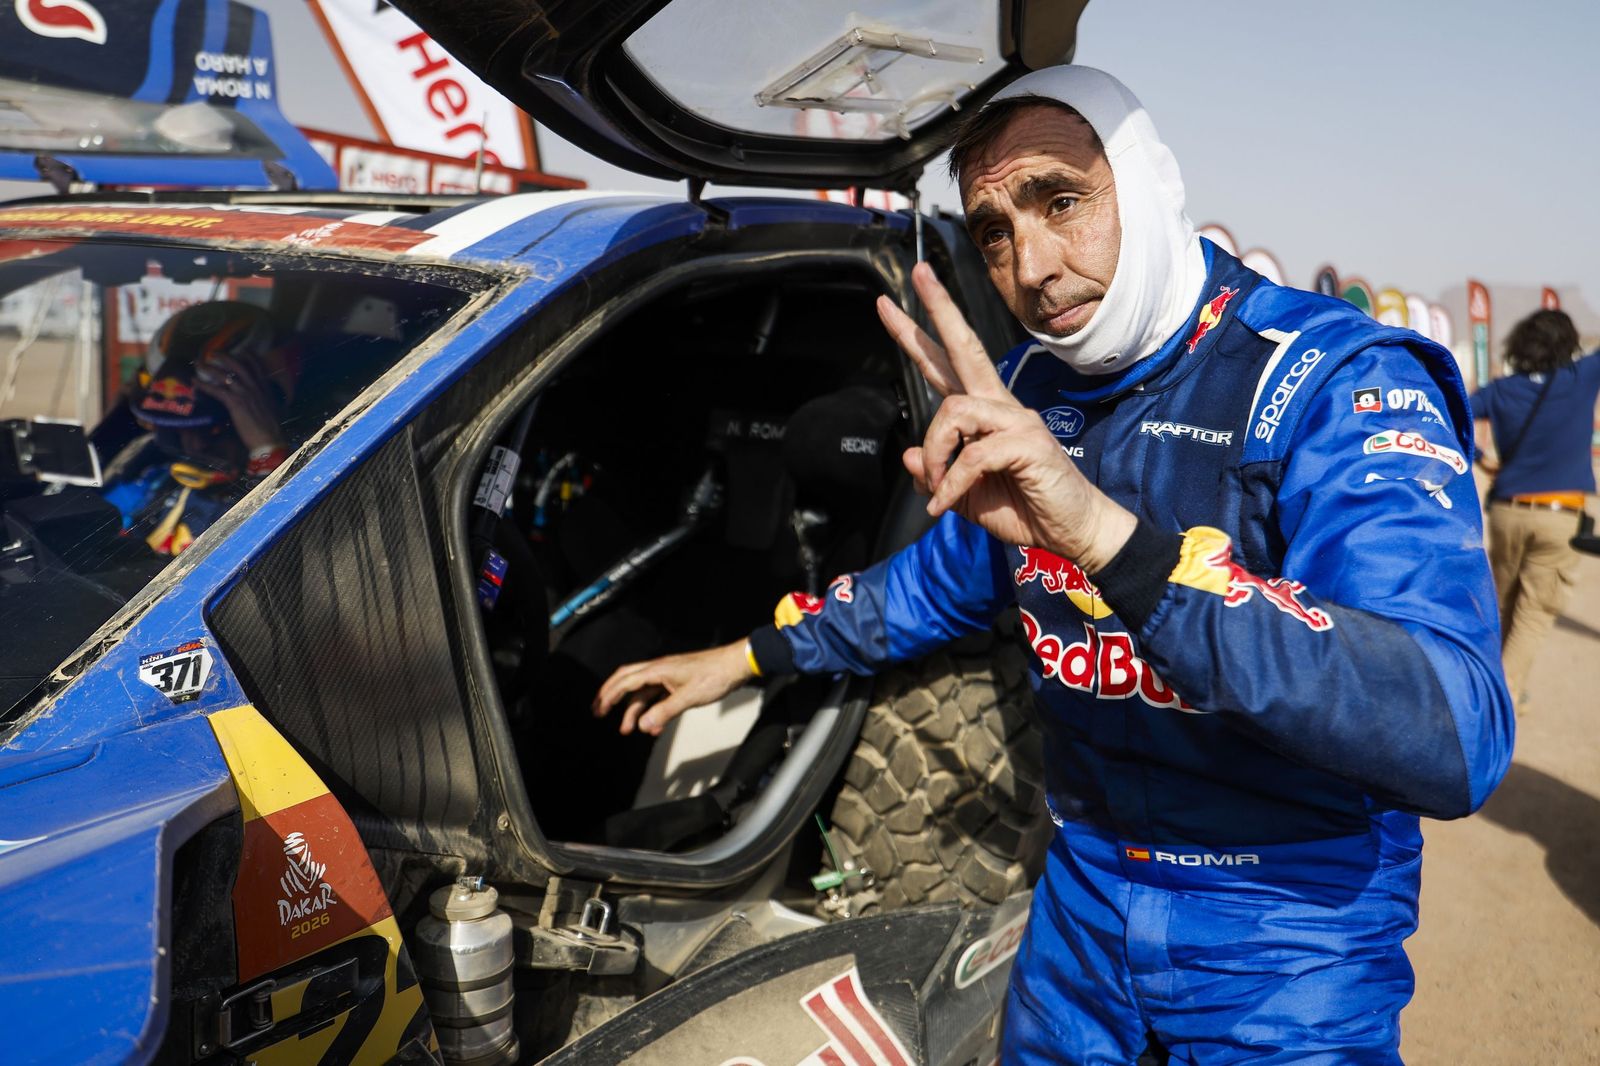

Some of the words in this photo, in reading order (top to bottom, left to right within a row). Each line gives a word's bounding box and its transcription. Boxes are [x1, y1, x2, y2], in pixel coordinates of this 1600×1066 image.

[195, 51, 253, 76] HARO
[252, 58, 269, 76] A
[193, 77, 254, 99] ROMA
[255, 81, 272, 100] N
[1255, 348, 1321, 440] sparco
[749, 422, 787, 440] ROM
[1045, 410, 1077, 433] Ford
[1140, 421, 1233, 446] RAPTOR
[841, 437, 878, 454] RECARO
[151, 655, 203, 693] 371
[1155, 850, 1260, 866] ROMA
[277, 883, 337, 926] DAKAR
[291, 912, 331, 939] 2026
